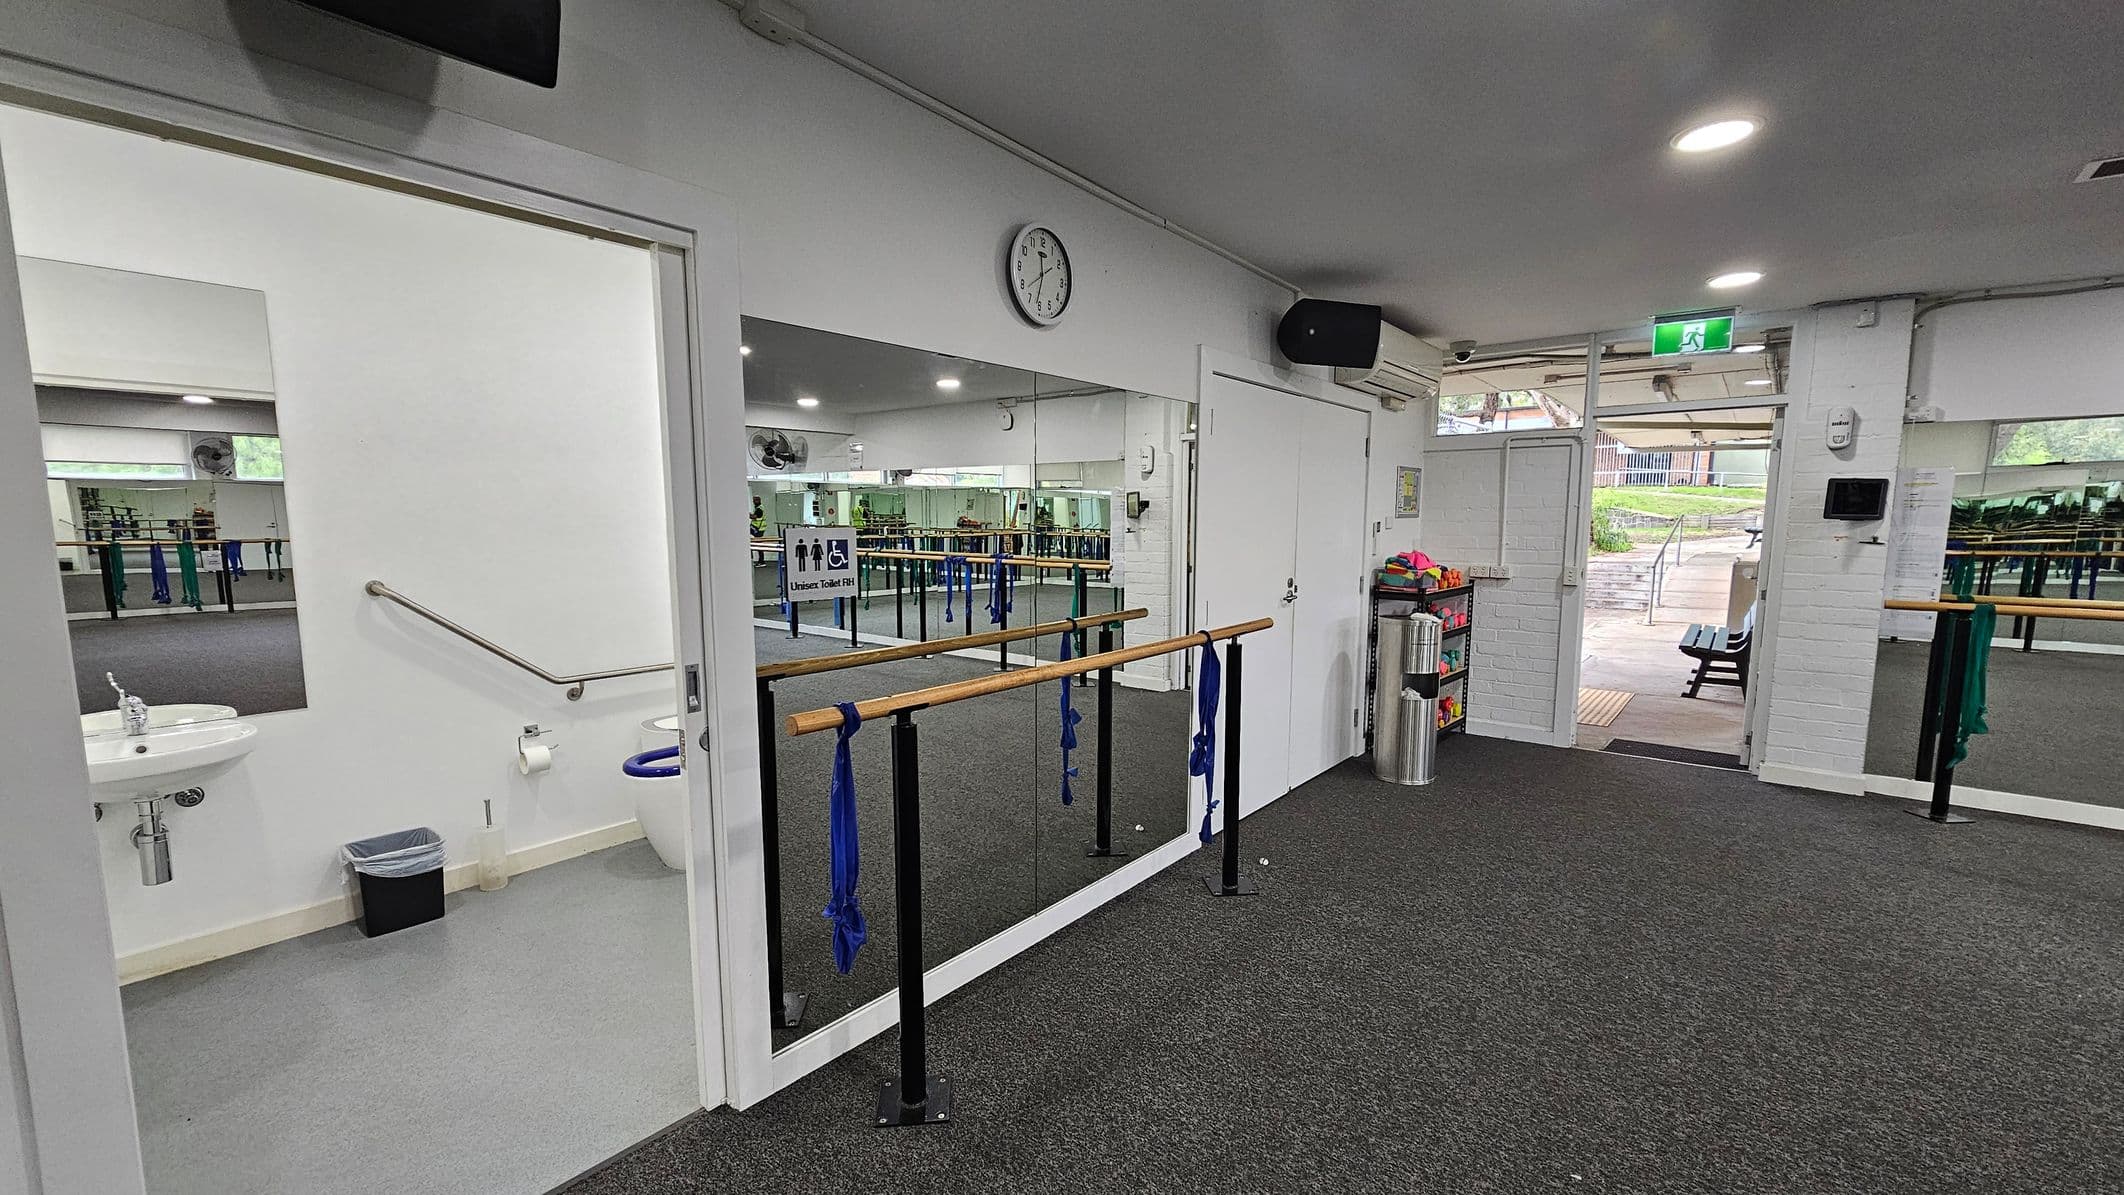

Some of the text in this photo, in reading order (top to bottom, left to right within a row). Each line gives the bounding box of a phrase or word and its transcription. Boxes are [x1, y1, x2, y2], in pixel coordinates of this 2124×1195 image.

[1030, 236, 1036, 248] 11
[1040, 236, 1046, 248] 12
[1022, 244, 1028, 256] 10
[1056, 259, 1061, 270] 2
[1020, 278, 1025, 290] 8
[1060, 278, 1064, 288] 3
[1028, 292, 1032, 303] 7
[1055, 292, 1060, 302] 4
[1038, 301, 1042, 312] 6
[1047, 300, 1052, 311] 5
[790, 578, 855, 591] Unisex Toilet RH
